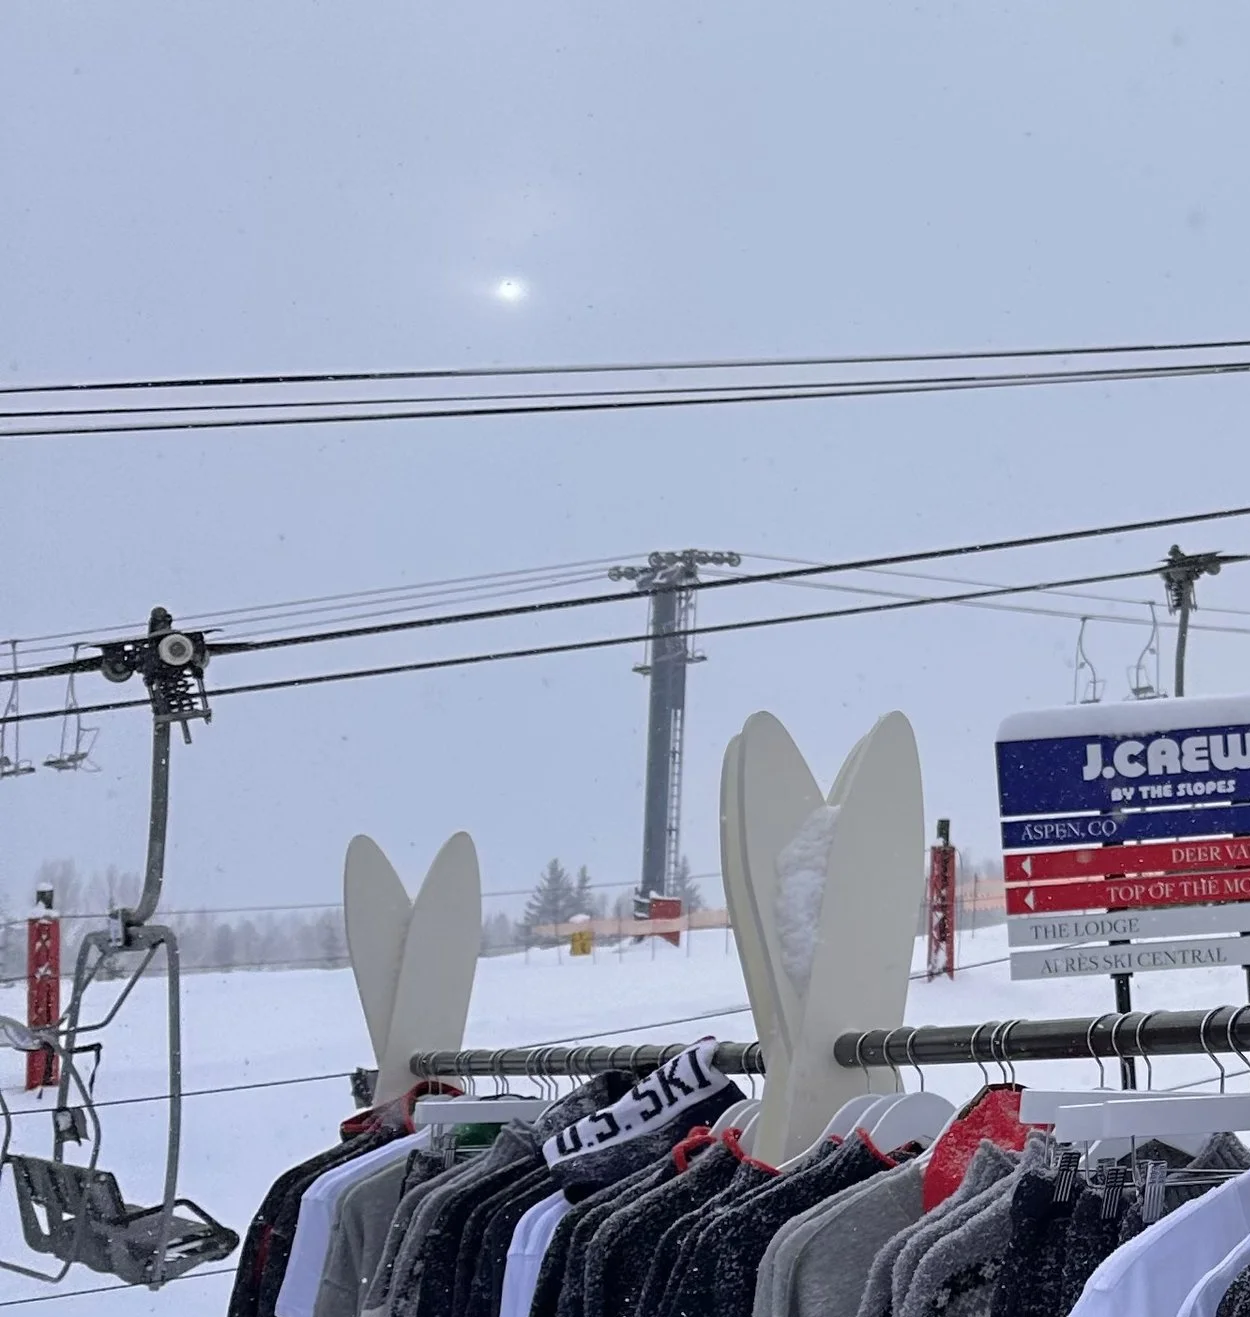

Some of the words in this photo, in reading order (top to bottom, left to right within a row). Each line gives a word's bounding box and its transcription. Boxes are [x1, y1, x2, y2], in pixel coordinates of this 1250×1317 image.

[1111, 787, 1135, 802] BY
[1138, 784, 1172, 800] THE
[1176, 780, 1236, 797] SLOPES
[1021, 822, 1086, 841] ASPEN,
[1088, 820, 1117, 837] CO
[1172, 846, 1221, 863] DEER
[1106, 884, 1145, 903] TOP
[1148, 883, 1175, 899] OF
[1179, 878, 1218, 896] THE
[1030, 923, 1069, 940] THE
[1074, 918, 1140, 938] LODGE
[1103, 953, 1133, 970] SKI
[1137, 948, 1227, 968] CENTRAL
[556, 1110, 632, 1156] U.S.
[632, 1050, 712, 1122] SKI
